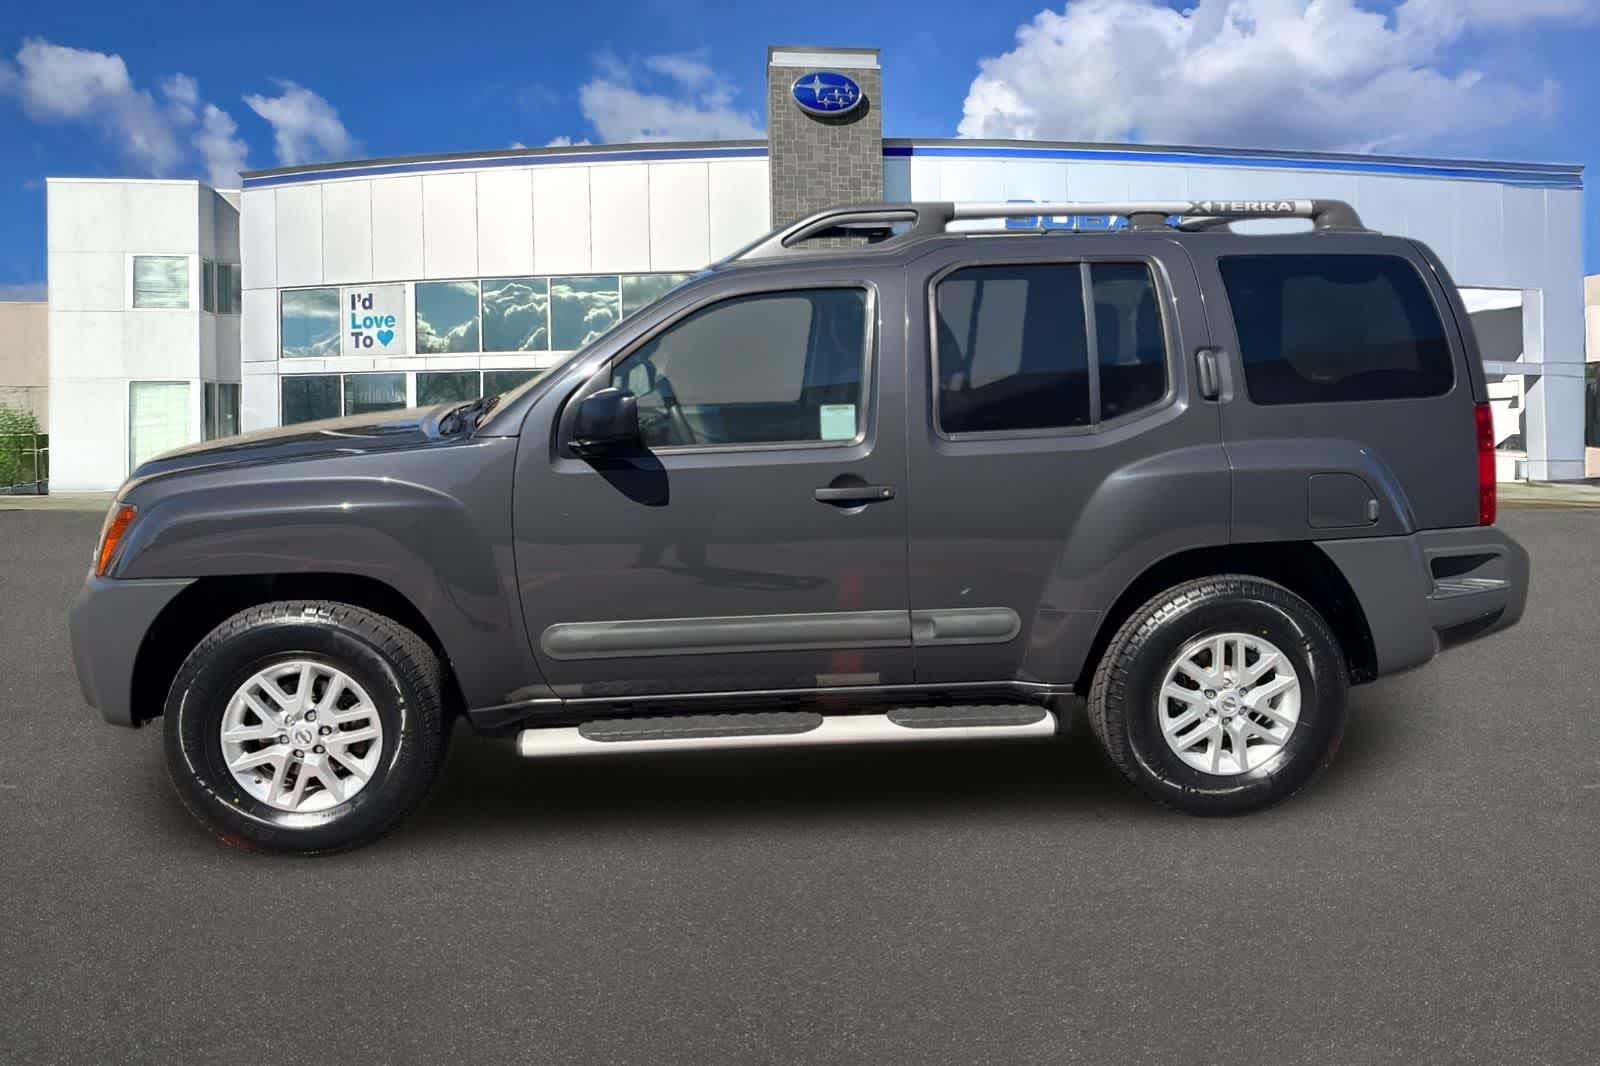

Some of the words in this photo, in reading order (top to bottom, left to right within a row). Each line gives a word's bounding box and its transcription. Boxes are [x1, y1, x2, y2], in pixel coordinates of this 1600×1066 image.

[1187, 200, 1293, 213] XTERRA
[351, 293, 373, 310] I'd
[351, 312, 396, 329] Love
[351, 332, 374, 348] To
